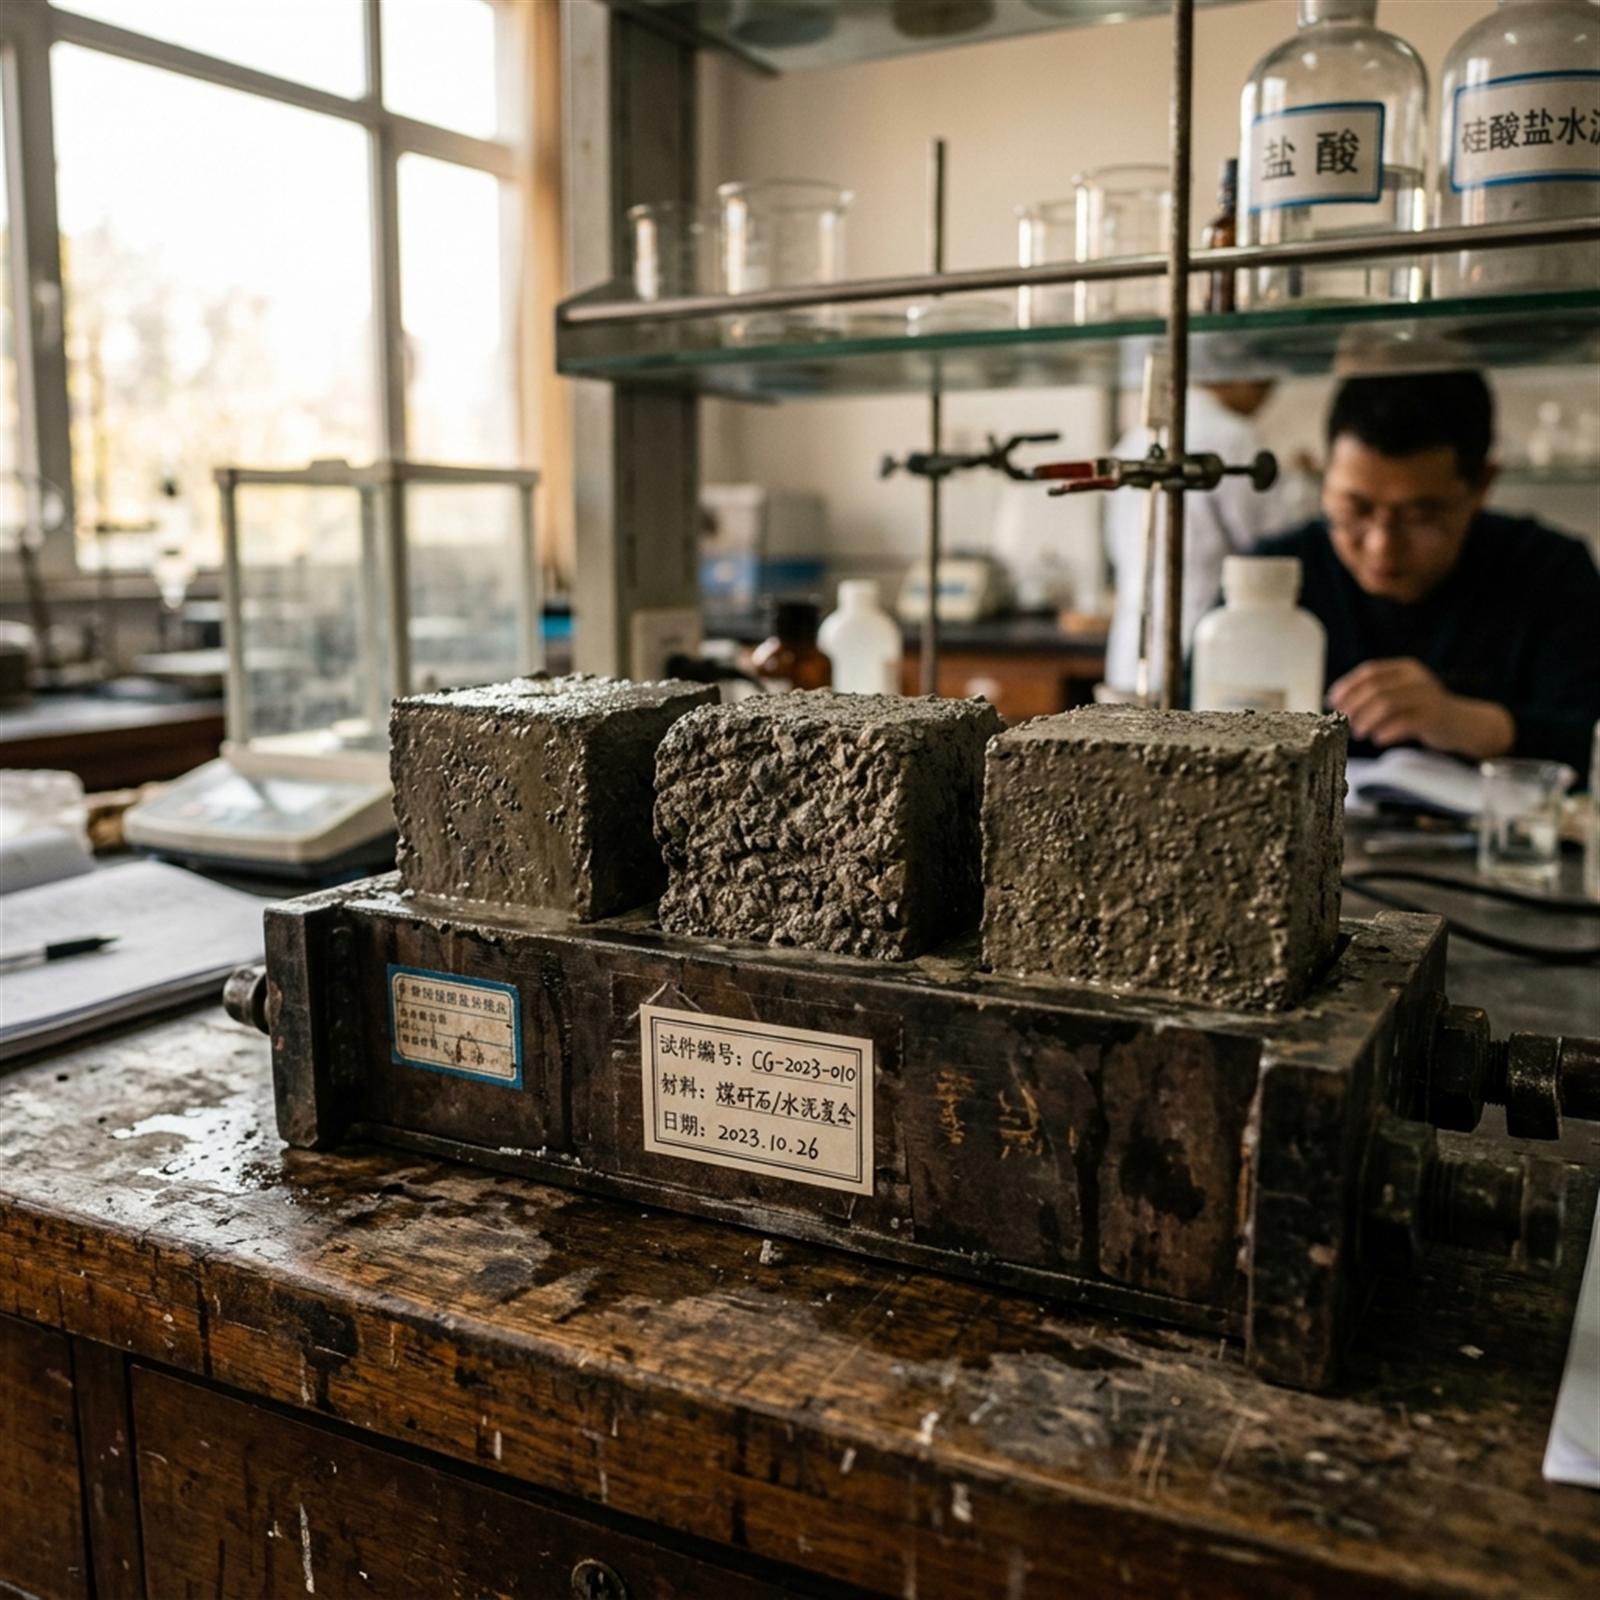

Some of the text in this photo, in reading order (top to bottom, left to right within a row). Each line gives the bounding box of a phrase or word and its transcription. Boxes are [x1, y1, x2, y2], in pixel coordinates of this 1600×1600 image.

[752, 1050, 856, 1082] CG-2023-010
[664, 1110, 819, 1160] 日期： 2023.10.26
